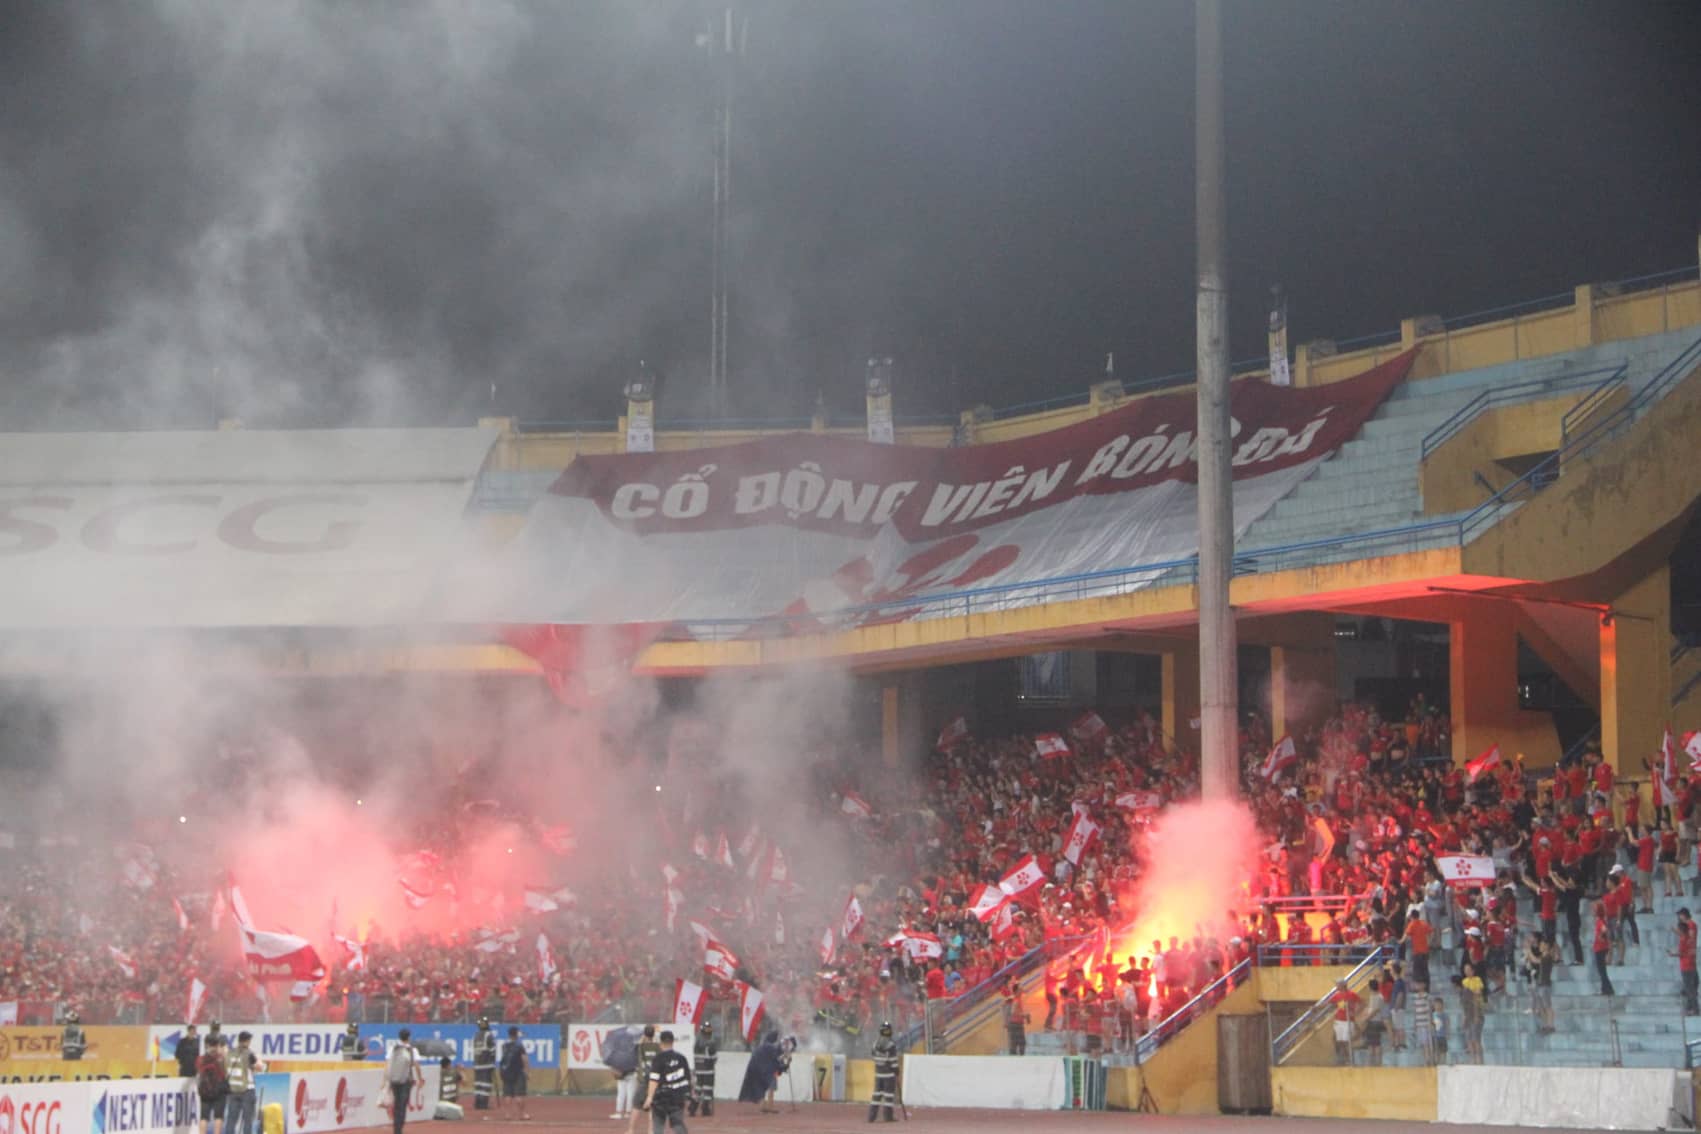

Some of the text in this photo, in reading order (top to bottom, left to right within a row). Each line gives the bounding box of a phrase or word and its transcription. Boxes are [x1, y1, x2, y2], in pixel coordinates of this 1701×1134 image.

[611, 463, 718, 519] CỔ
[920, 465, 1072, 527] VIÊN
[262, 1033, 346, 1055] MEDIA
[108, 1091, 198, 1132] NEXT MEDIA
